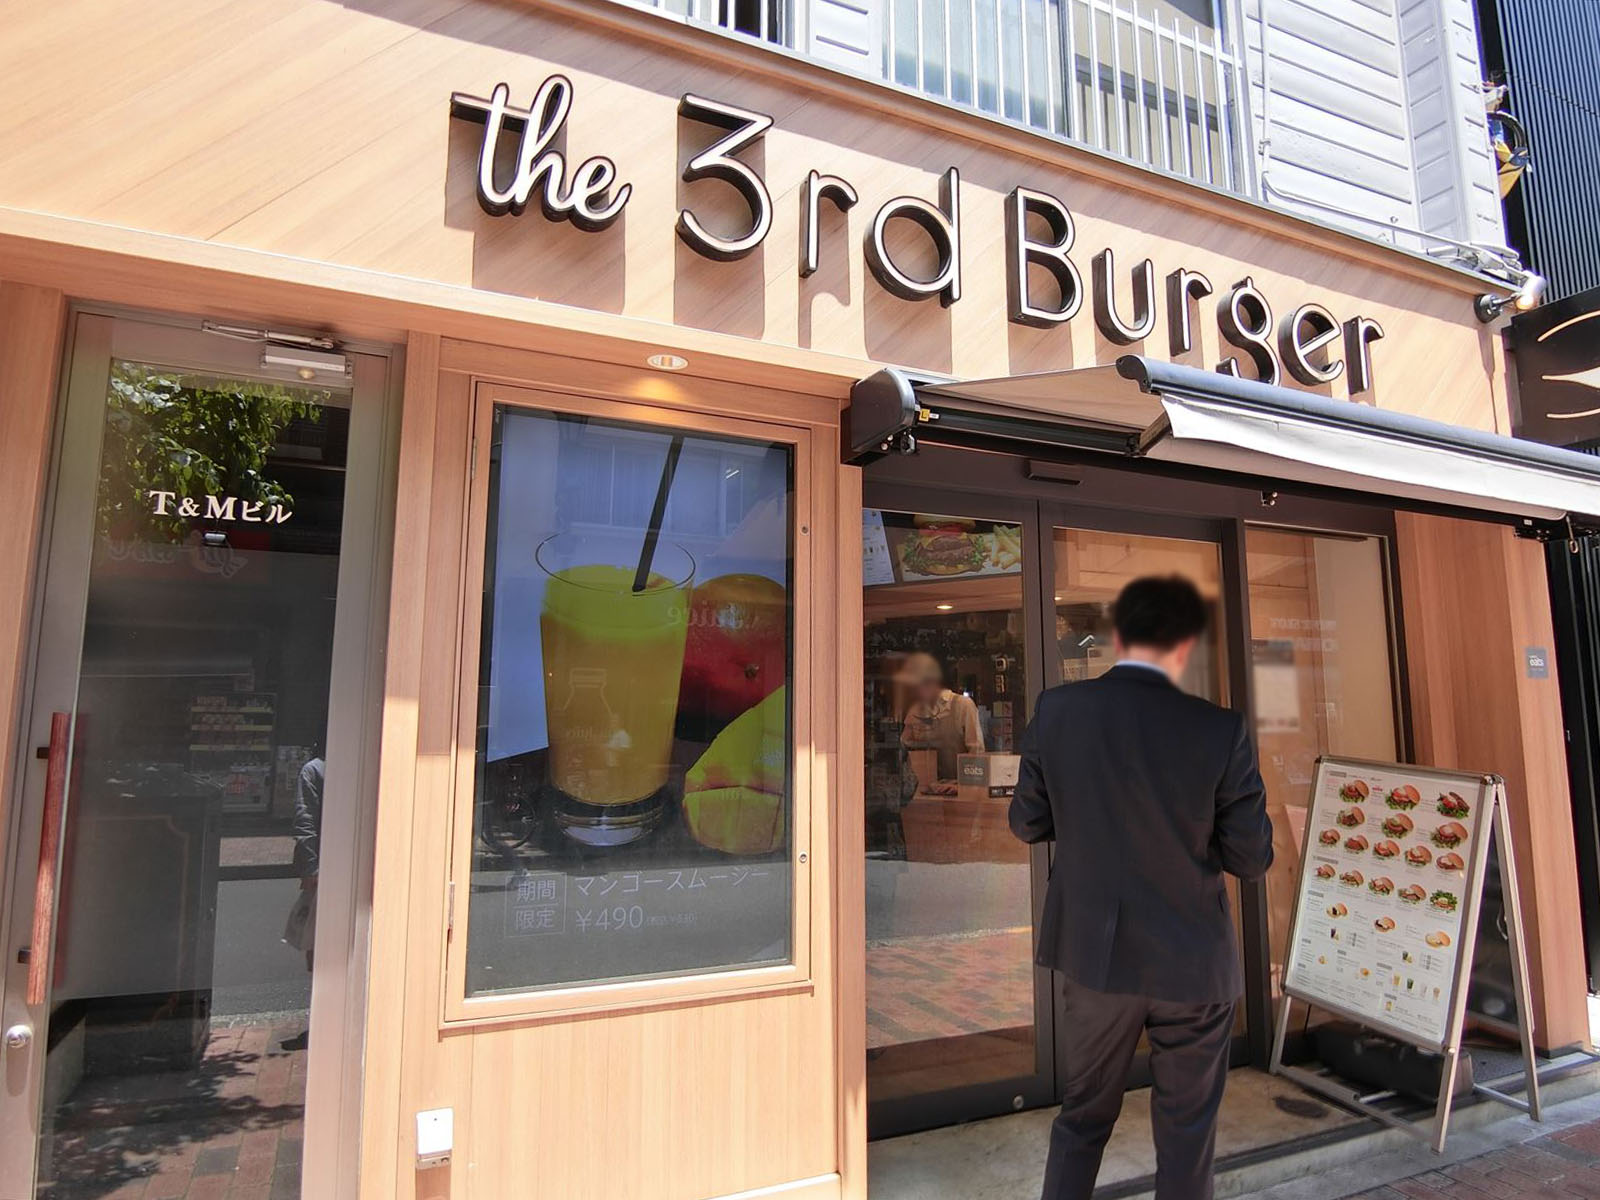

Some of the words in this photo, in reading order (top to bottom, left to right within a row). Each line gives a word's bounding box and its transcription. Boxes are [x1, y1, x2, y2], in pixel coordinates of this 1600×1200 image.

[450, 73, 632, 232] the
[675, 93, 962, 310] 3rd
[1004, 185, 1386, 394] Burger
[149, 490, 293, 525] T&Mビル
[517, 880, 556, 902] 期間
[574, 867, 770, 896] マンゴースムージー
[515, 909, 555, 930] 限定
